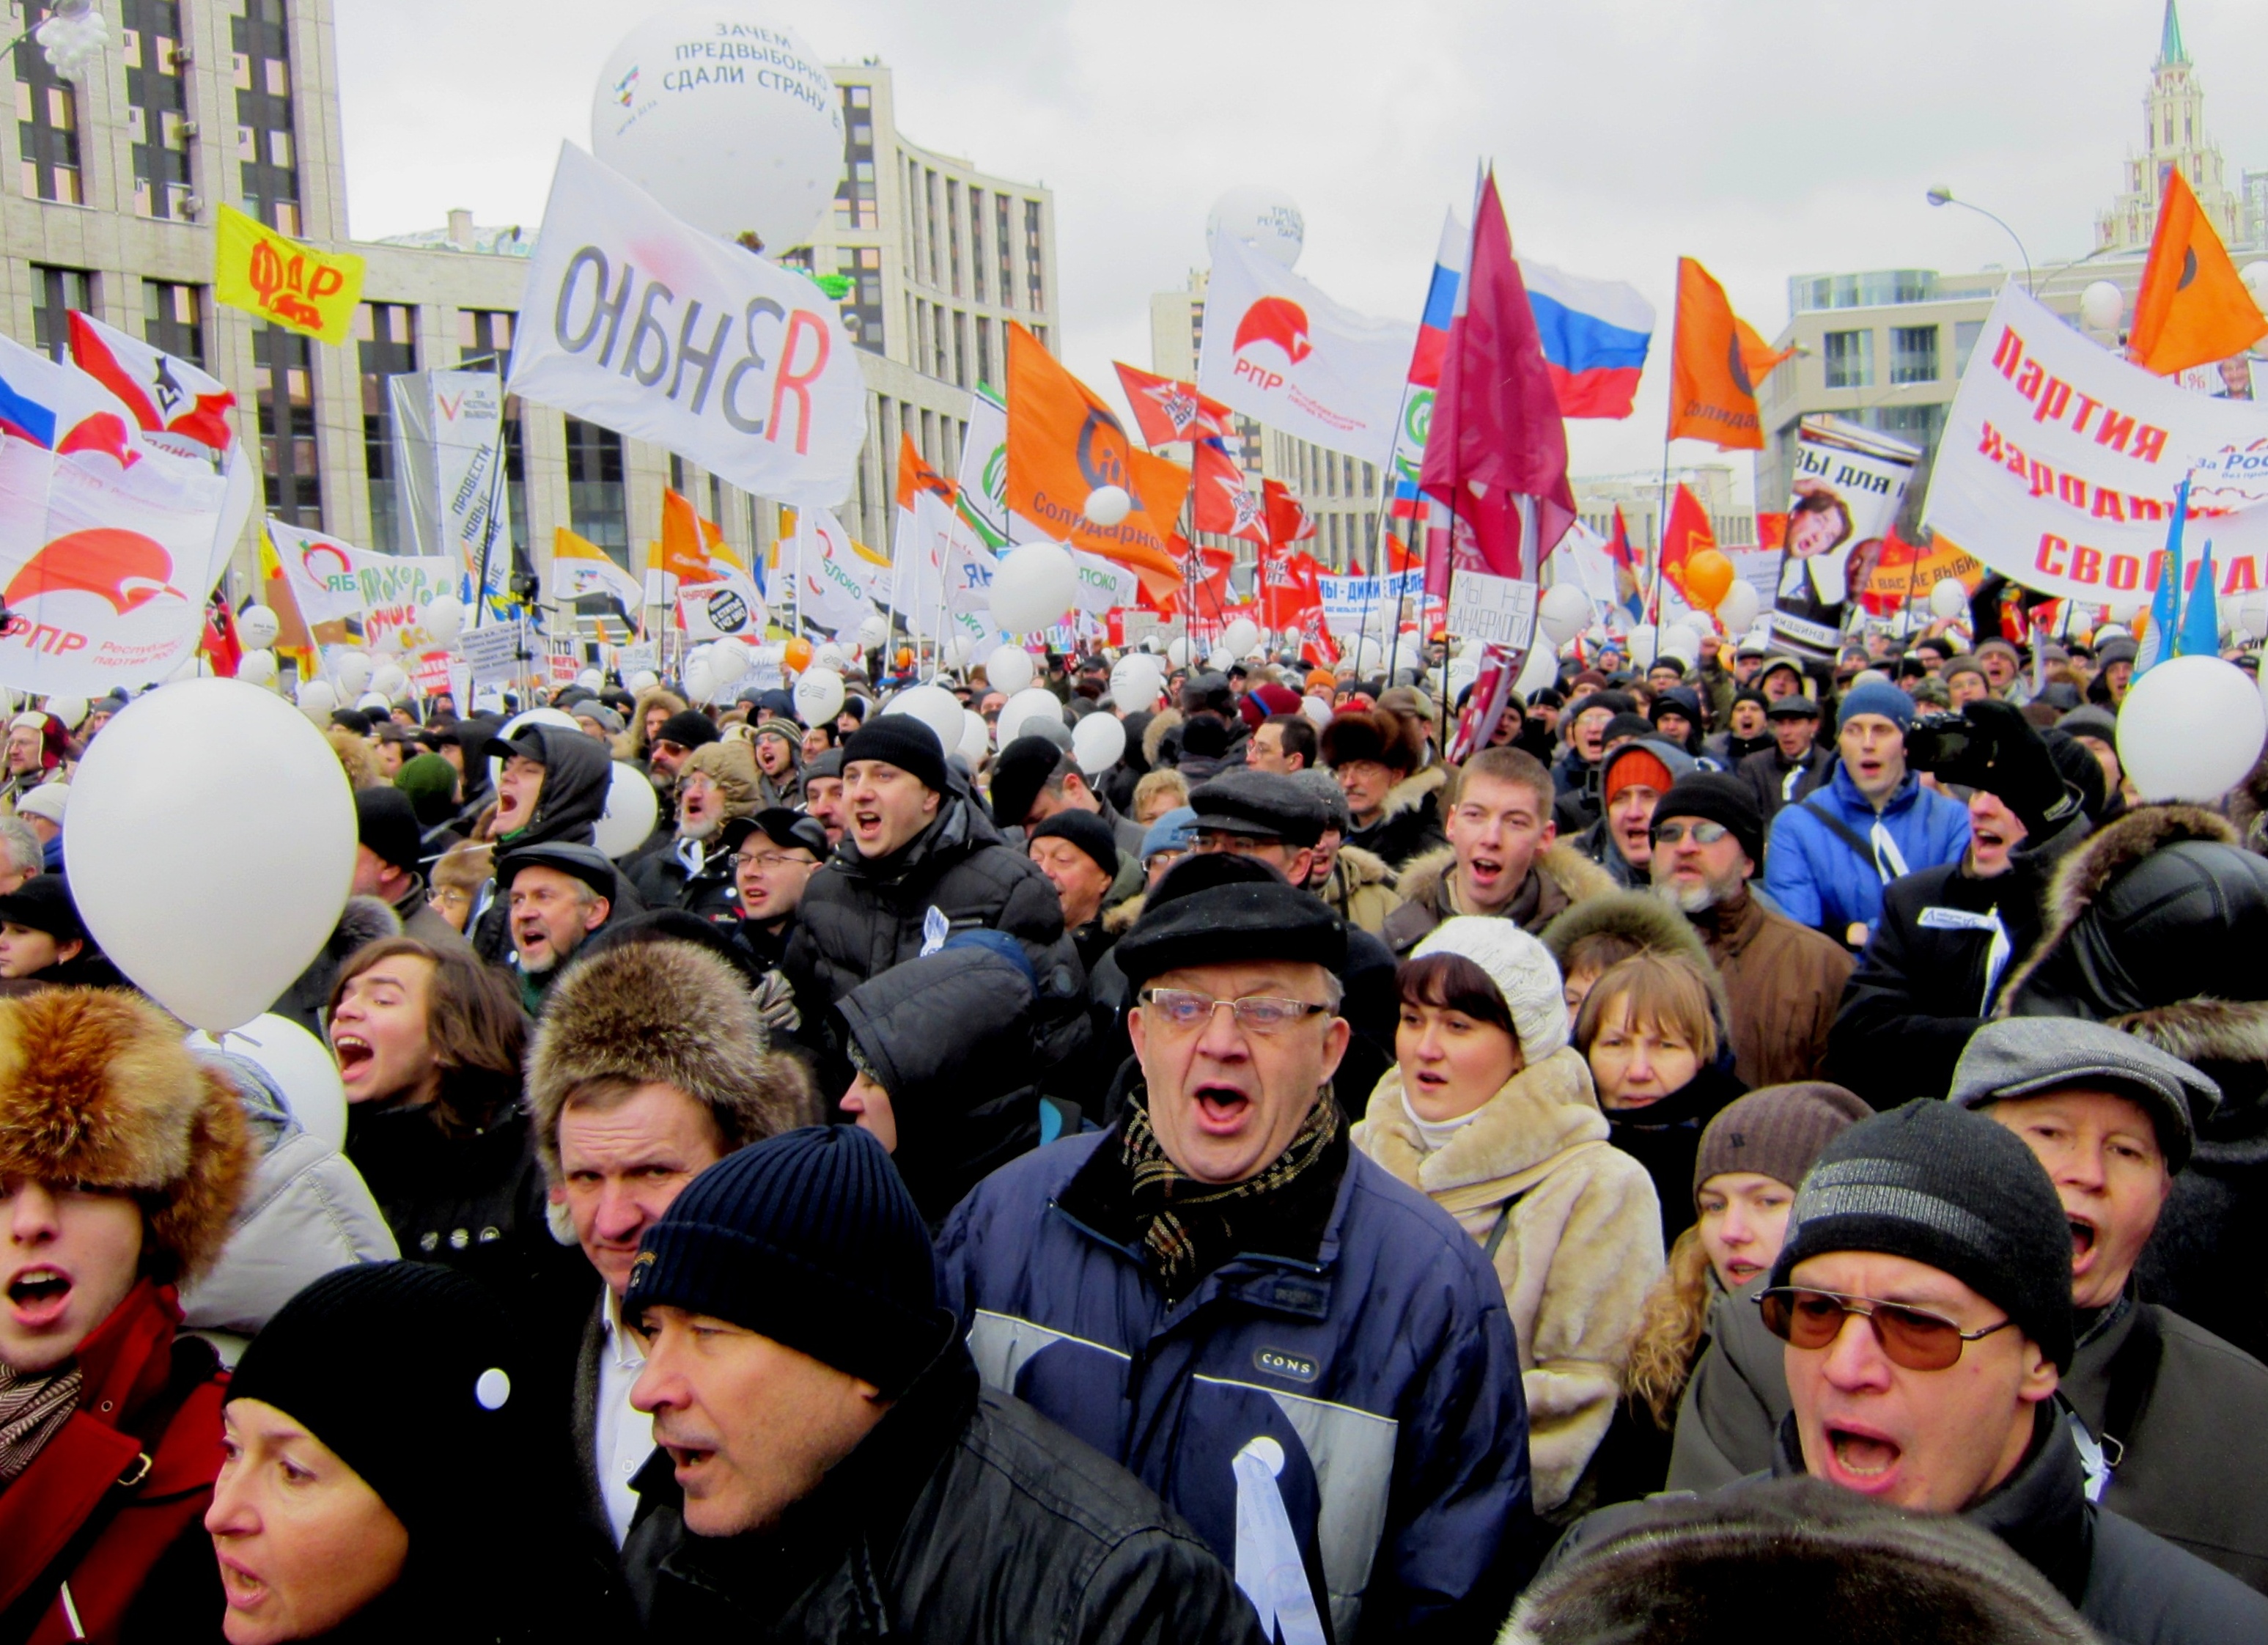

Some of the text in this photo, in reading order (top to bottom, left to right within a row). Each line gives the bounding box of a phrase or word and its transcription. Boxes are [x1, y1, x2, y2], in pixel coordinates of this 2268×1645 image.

[663, 65, 825, 112] СДАЛИ СТРАНУ
[1233, 358, 1284, 391] РПР
[452, 444, 492, 515] ПРОВЕСТИ
[1835, 464, 1891, 496] ДЛЯ
[1454, 575, 1531, 614] МЫ НЕ
[1262, 1353, 1311, 1374] CONS
